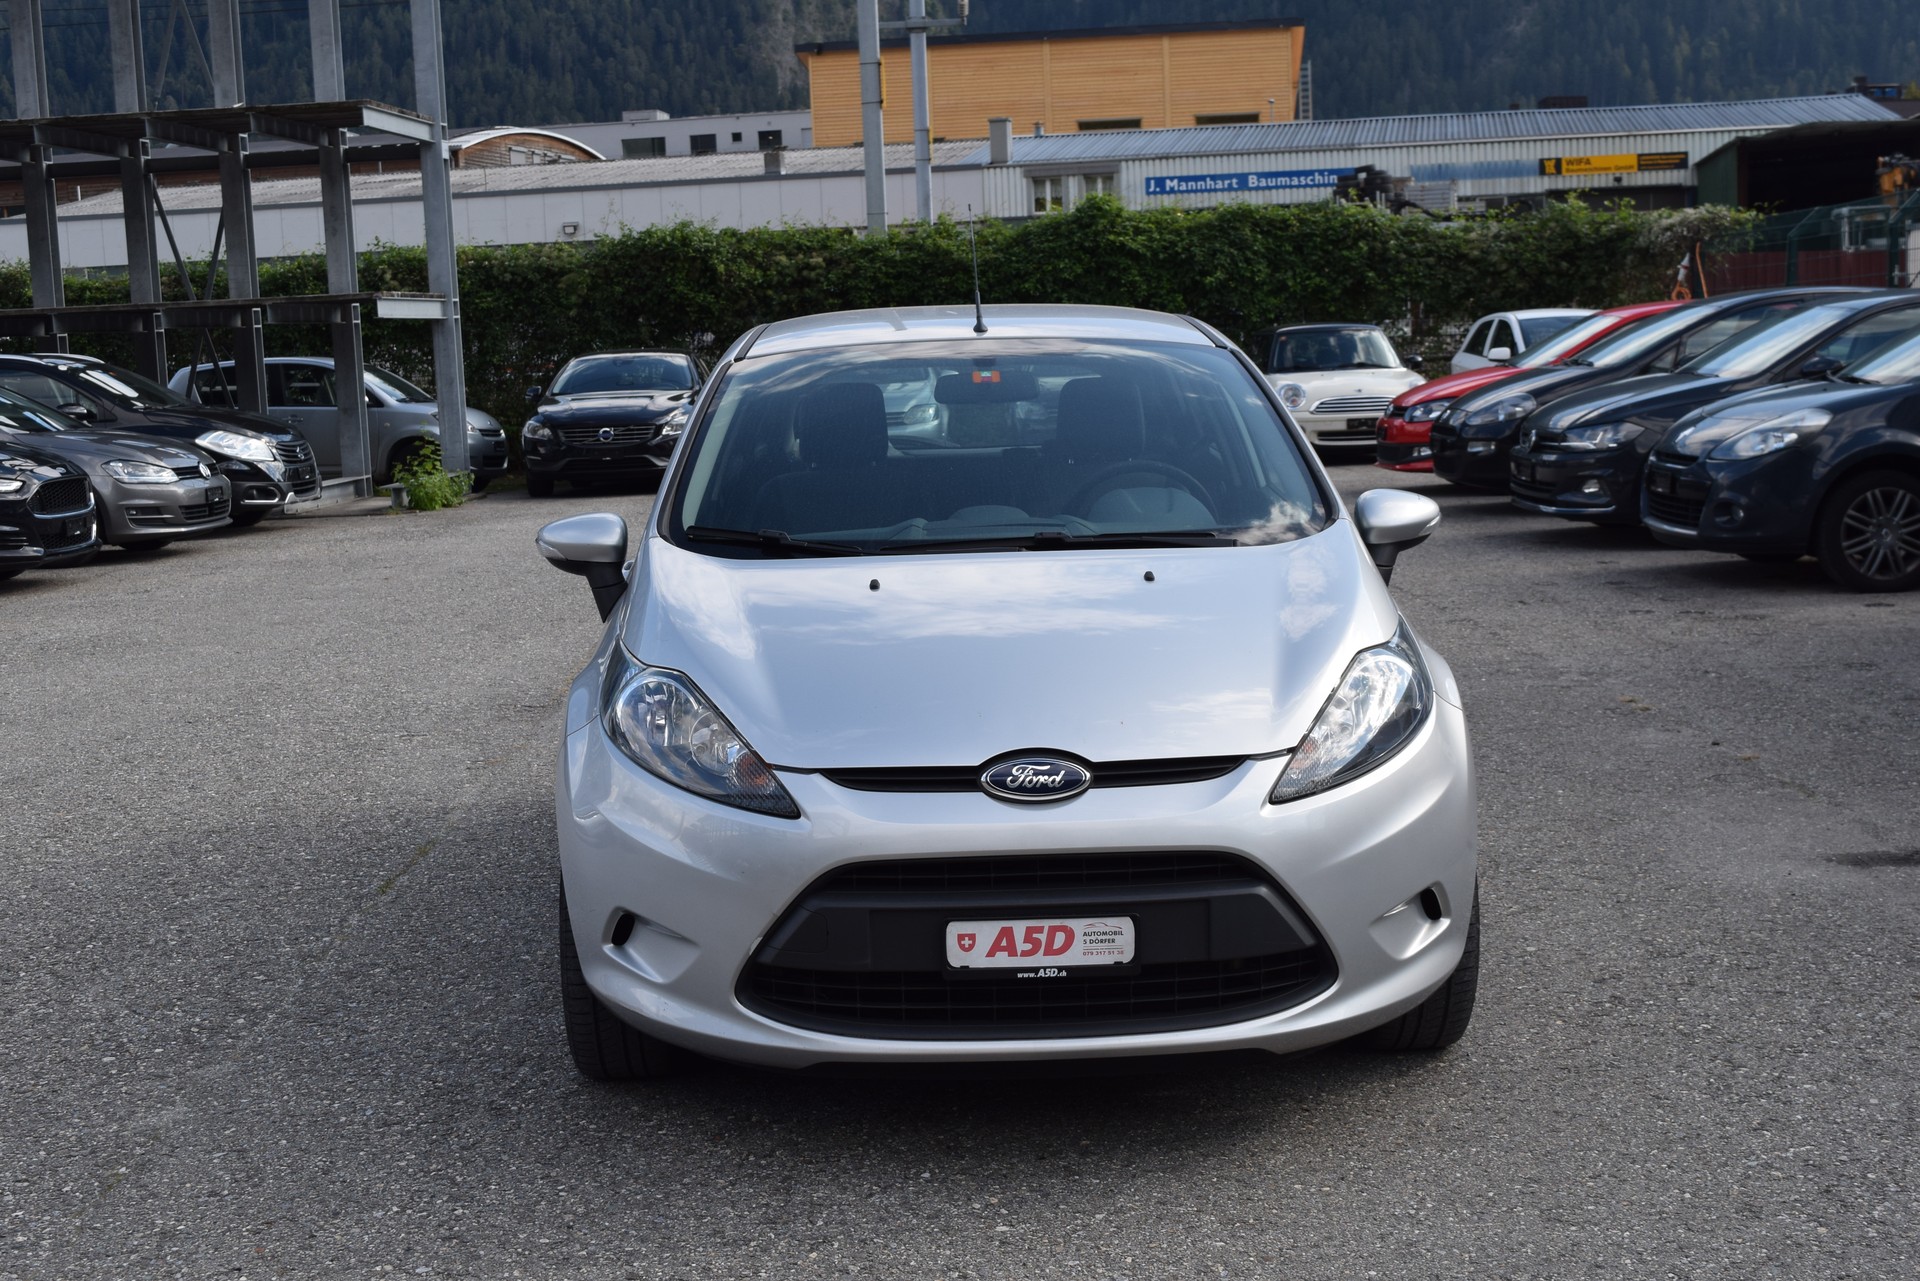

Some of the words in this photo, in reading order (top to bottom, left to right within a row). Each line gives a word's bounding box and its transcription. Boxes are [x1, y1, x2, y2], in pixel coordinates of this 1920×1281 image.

[1565, 157, 1592, 166] WIFA
[1148, 179, 1160, 192] J.
[1165, 177, 1239, 192] Mannhart
[1006, 764, 1065, 788] Ford
[985, 925, 1076, 958] A5D
[1017, 968, 1067, 978] www.A5D.ch
